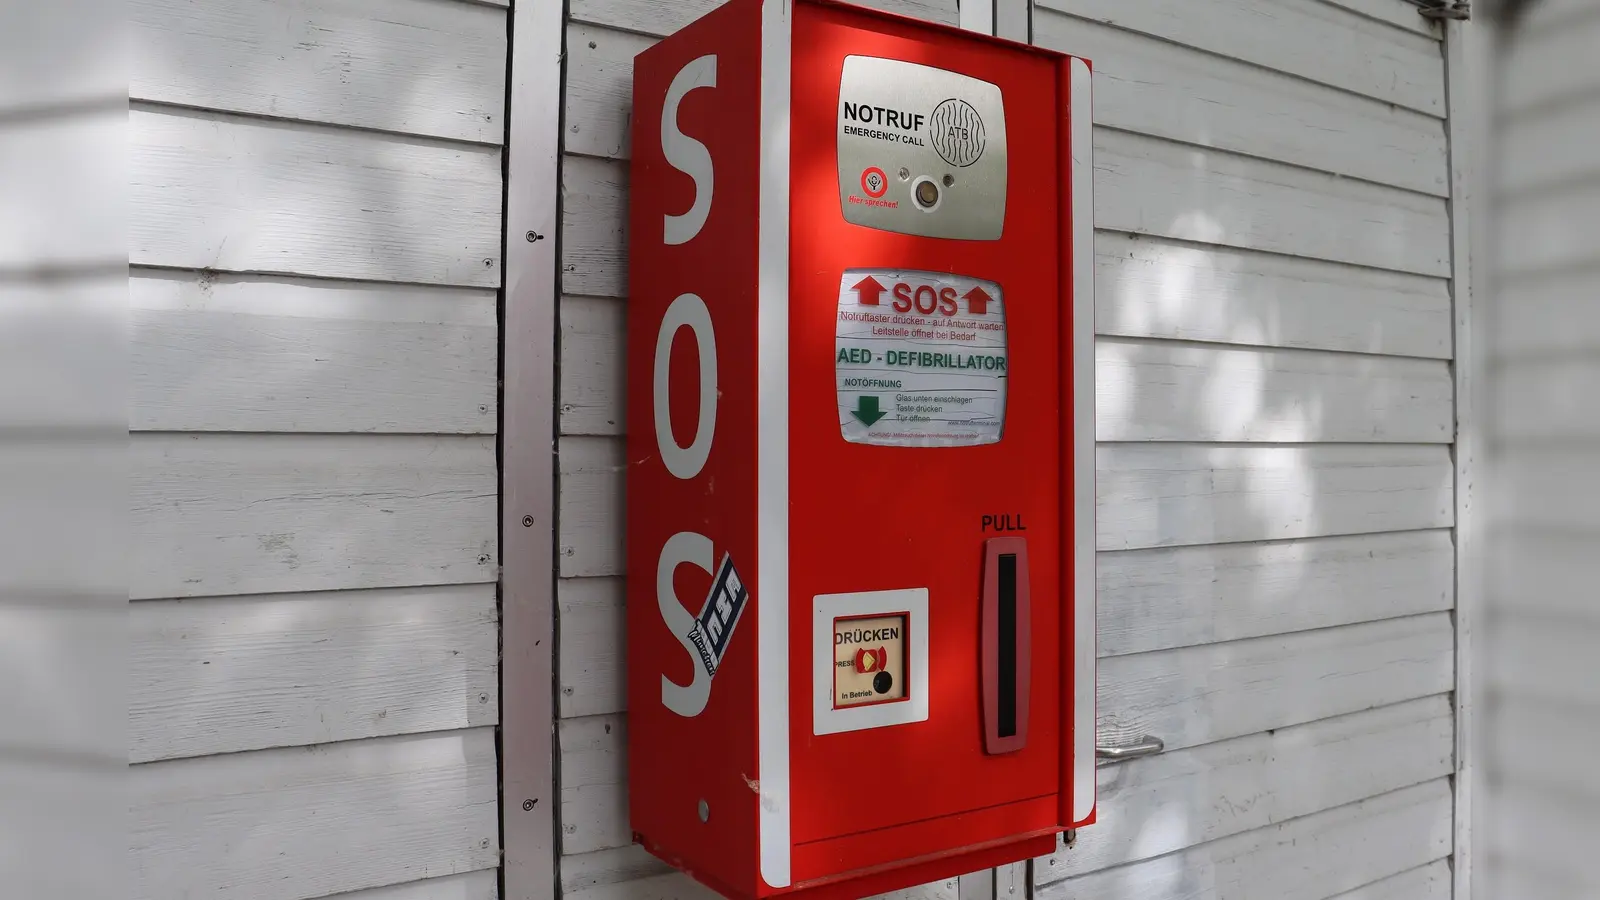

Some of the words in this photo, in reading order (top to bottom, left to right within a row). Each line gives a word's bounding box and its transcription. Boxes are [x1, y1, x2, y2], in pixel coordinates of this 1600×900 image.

[843, 101, 924, 131] NOTRUF
[843, 125, 900, 143] EMERGENCY
[902, 134, 925, 147] CALL
[948, 126, 969, 140] ATB
[848, 195, 864, 204] Hier
[864, 198, 899, 209] sprechen!
[892, 282, 958, 316] SOS
[840, 311, 890, 323] Notruftaster
[892, 314, 925, 325] drücken
[932, 318, 945, 327] auf
[946, 319, 977, 330] Antwort
[978, 322, 1004, 331] warten
[872, 325, 909, 337] Leitstelle
[911, 327, 934, 339] öffnet
[936, 330, 948, 339] bei
[950, 330, 977, 341] Bedarf
[837, 347, 872, 364] AED
[886, 350, 1006, 371] DEFIBRILLATOR
[844, 377, 902, 388] NOTÖFFNUNG
[896, 393, 912, 402] Glas
[913, 394, 933, 402] unten
[934, 395, 973, 405] einschlagen
[896, 404, 915, 412] Taste
[981, 514, 1026, 532] PULL
[836, 627, 899, 645] DRÜCKEN
[841, 692, 848, 700] In
[849, 689, 873, 699] Betrieb
